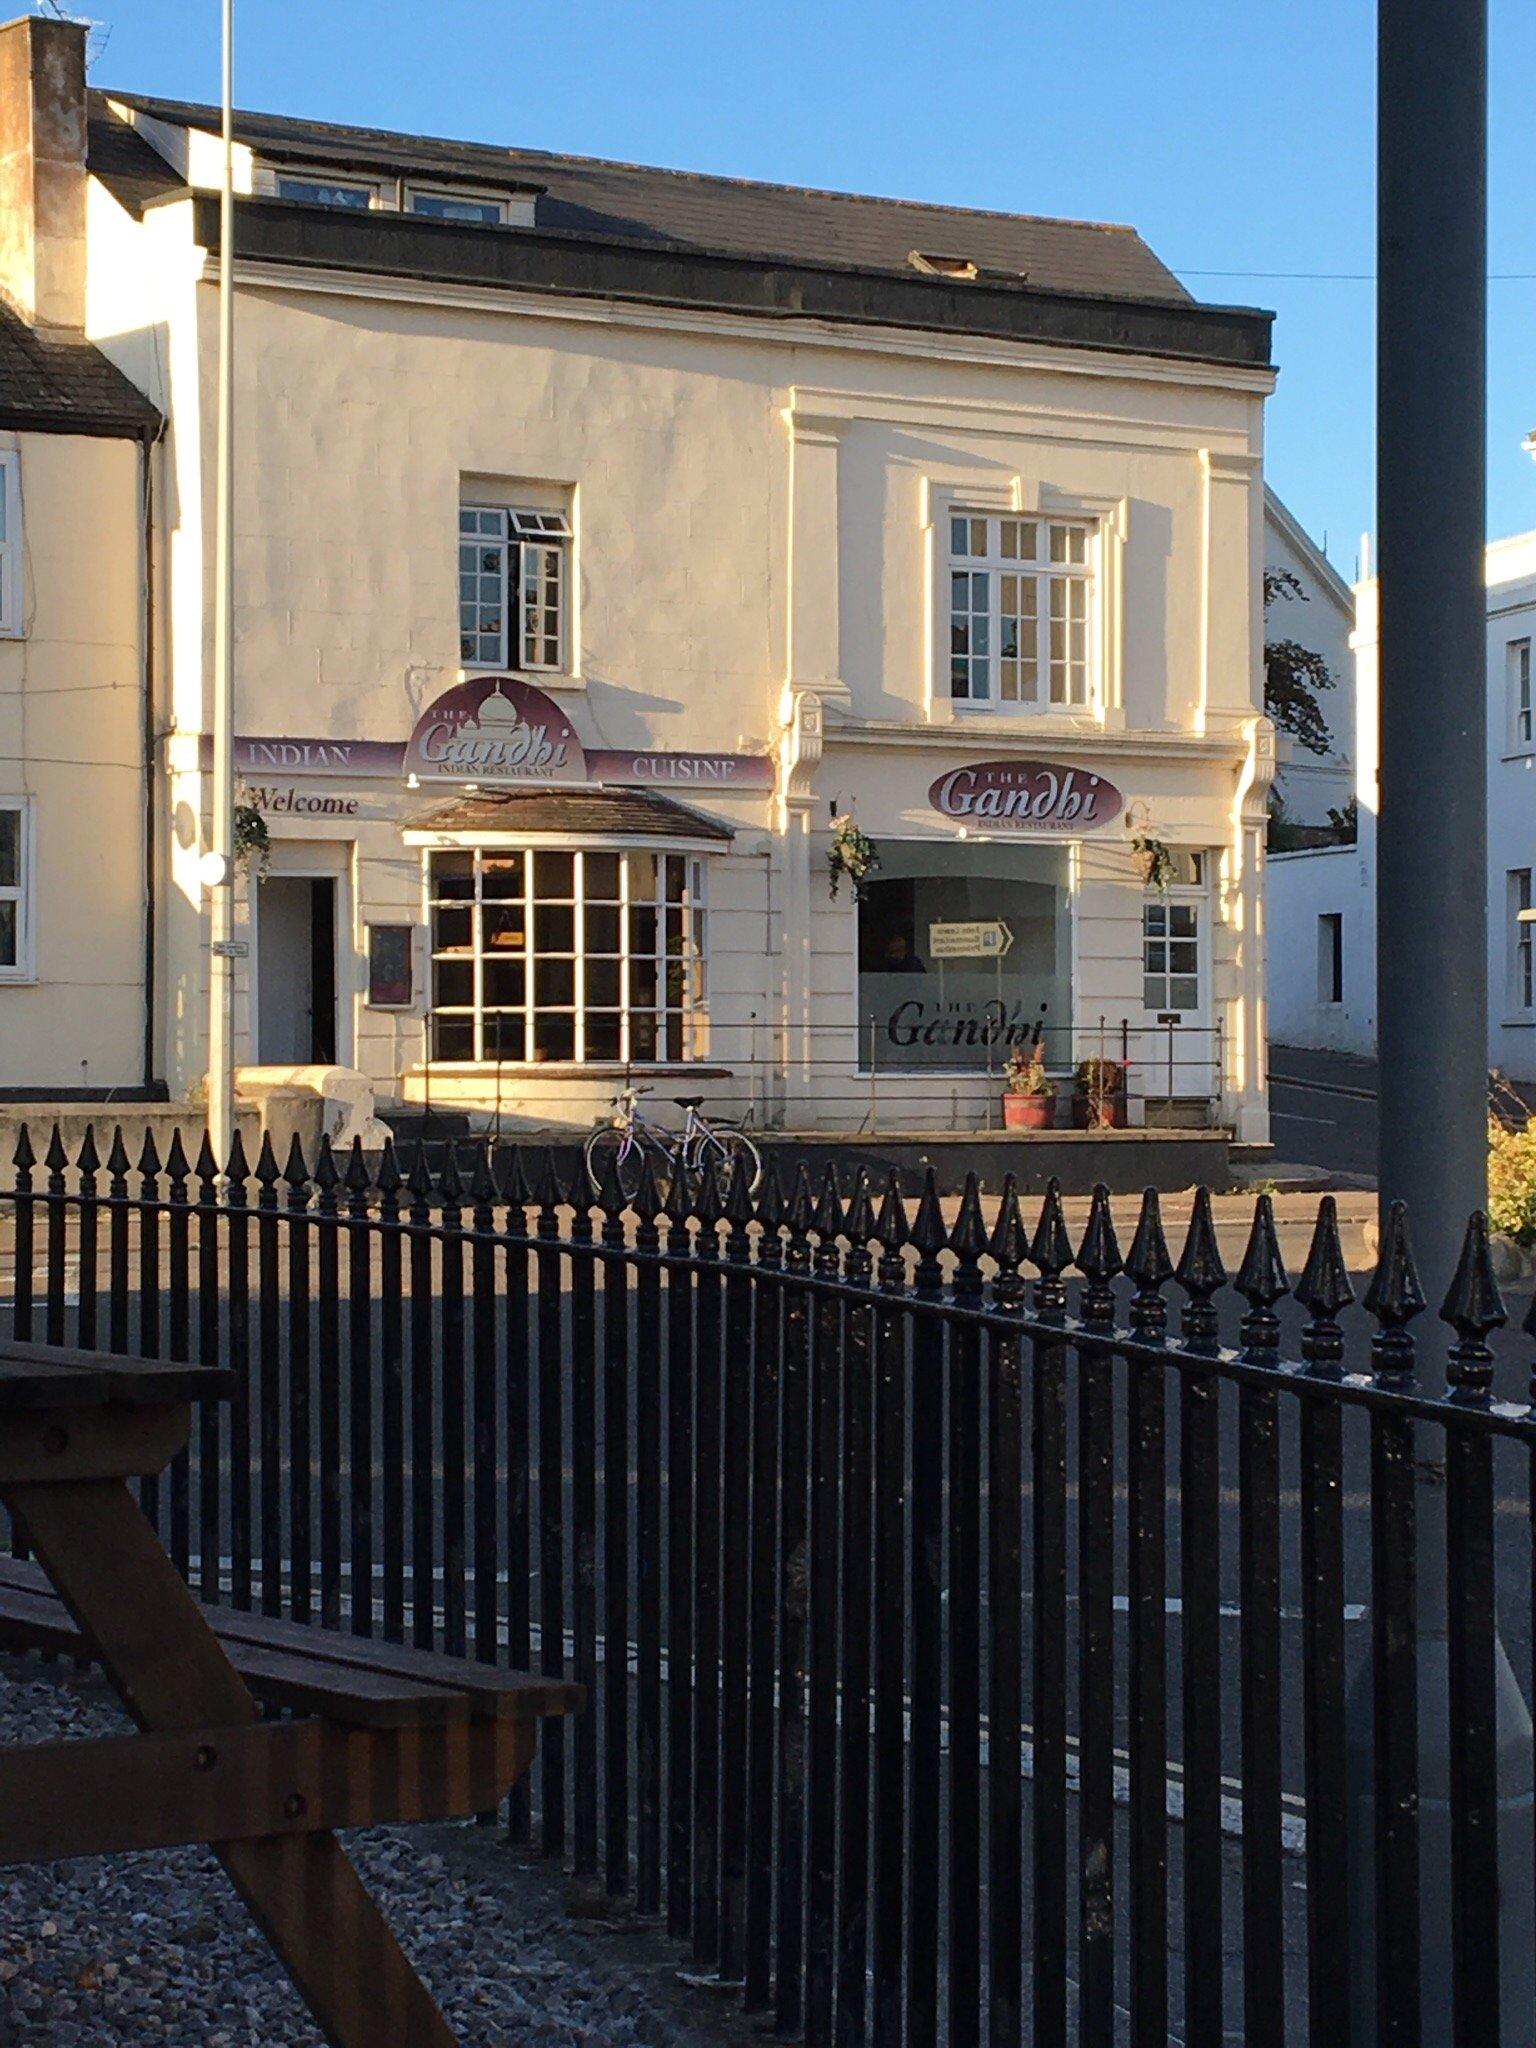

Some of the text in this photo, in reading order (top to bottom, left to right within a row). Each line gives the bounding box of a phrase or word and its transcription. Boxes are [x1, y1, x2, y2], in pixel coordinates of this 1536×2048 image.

[431, 709, 468, 720] THE
[248, 743, 352, 768] INDIAN
[418, 721, 571, 768] Gandhi
[437, 763, 555, 777] INDIAN RESTAURANT
[632, 756, 736, 779] CUISINE
[984, 771, 1028, 785] THE
[249, 786, 360, 815] Welcome
[940, 769, 1099, 821] Gandhi
[977, 819, 1074, 831] INDIAN RESTAURANT
[887, 999, 1048, 1046] Gandhi
